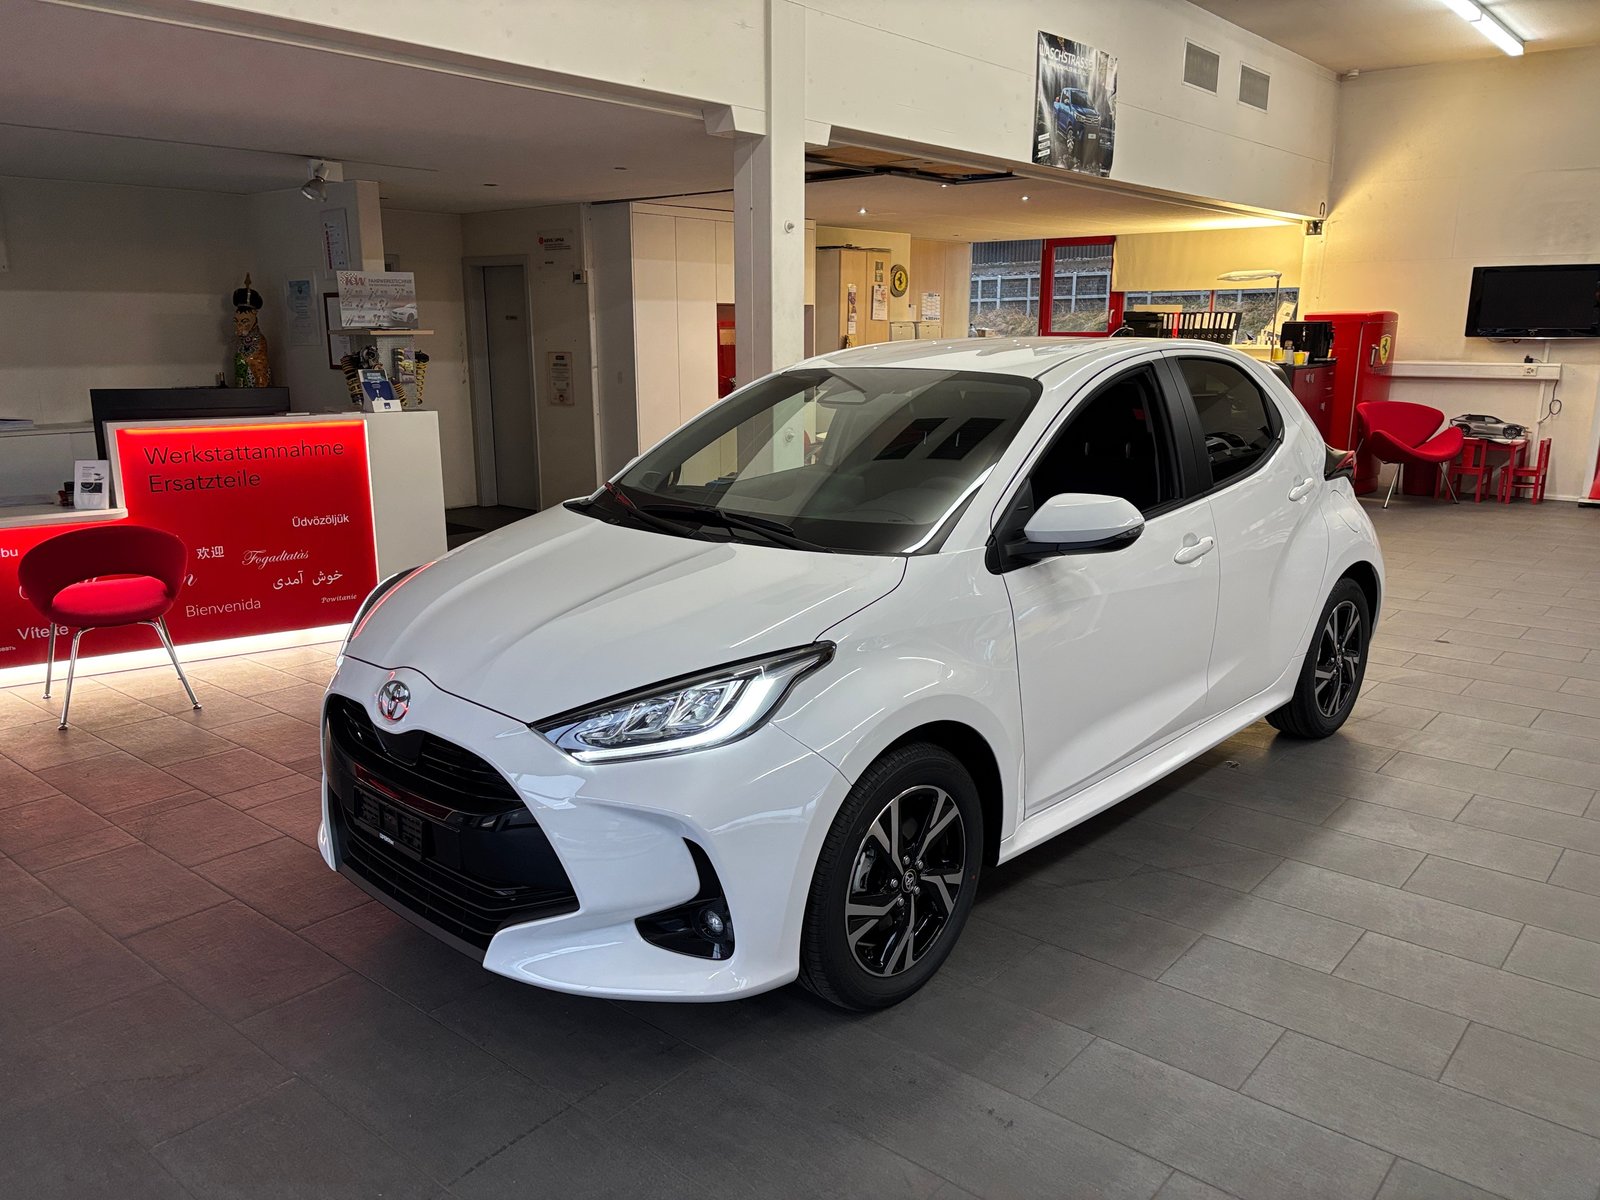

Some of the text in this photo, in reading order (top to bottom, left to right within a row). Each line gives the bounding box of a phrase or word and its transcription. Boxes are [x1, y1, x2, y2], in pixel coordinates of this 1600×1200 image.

[344, 276, 366, 286] KW
[144, 440, 345, 465] Werkstattannahme
[149, 470, 261, 493] Ersatzteile
[292, 514, 350, 528] Üdvözöljük
[196, 546, 224, 560] 欢迎
[312, 570, 343, 585] خوش
[321, 594, 357, 604] Powitanie
[185, 598, 262, 618] Bienvenida
[17, 626, 69, 641] Vítete
